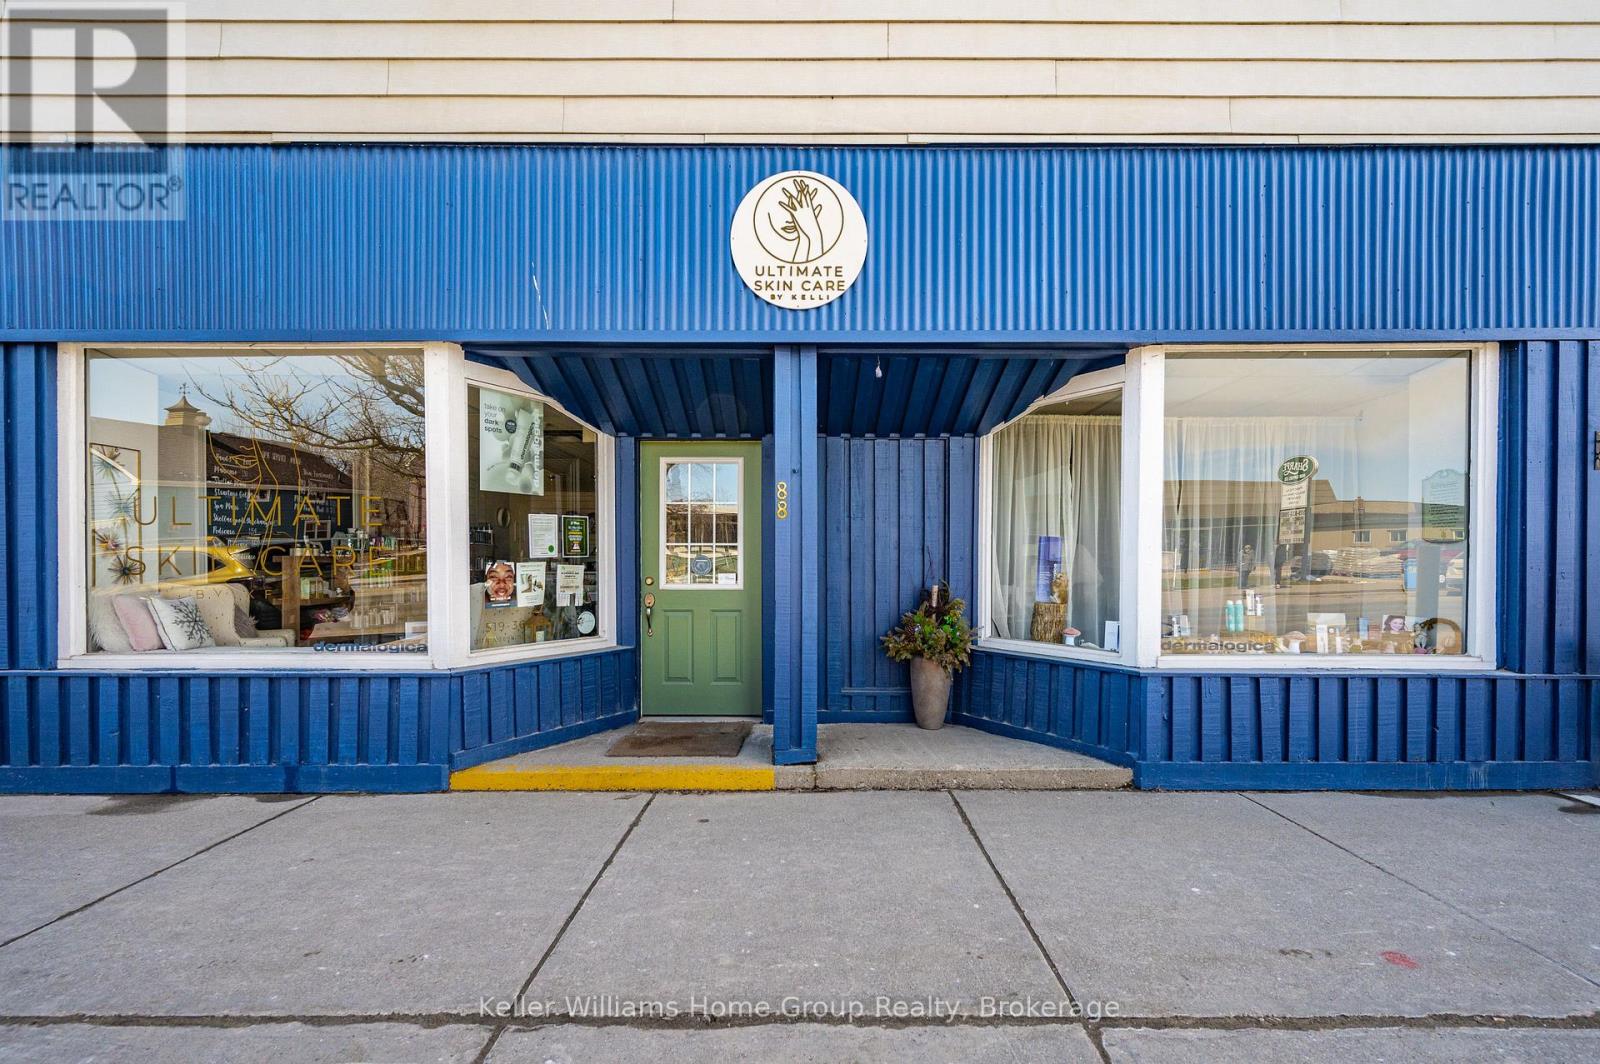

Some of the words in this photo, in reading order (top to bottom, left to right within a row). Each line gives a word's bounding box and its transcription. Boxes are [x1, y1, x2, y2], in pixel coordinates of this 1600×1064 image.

[755, 265, 843, 277] ULTIMATE
[754, 280, 793, 292] SKIN
[801, 280, 846, 292] CARE
[484, 417, 499, 426] dark
[484, 426, 503, 434] spots
[777, 481, 787, 519] 88
[134, 495, 384, 527] ULTIMATE
[260, 545, 392, 576] CARE
[313, 641, 427, 654] dermalogica
[1161, 639, 1276, 653] dermalogica
